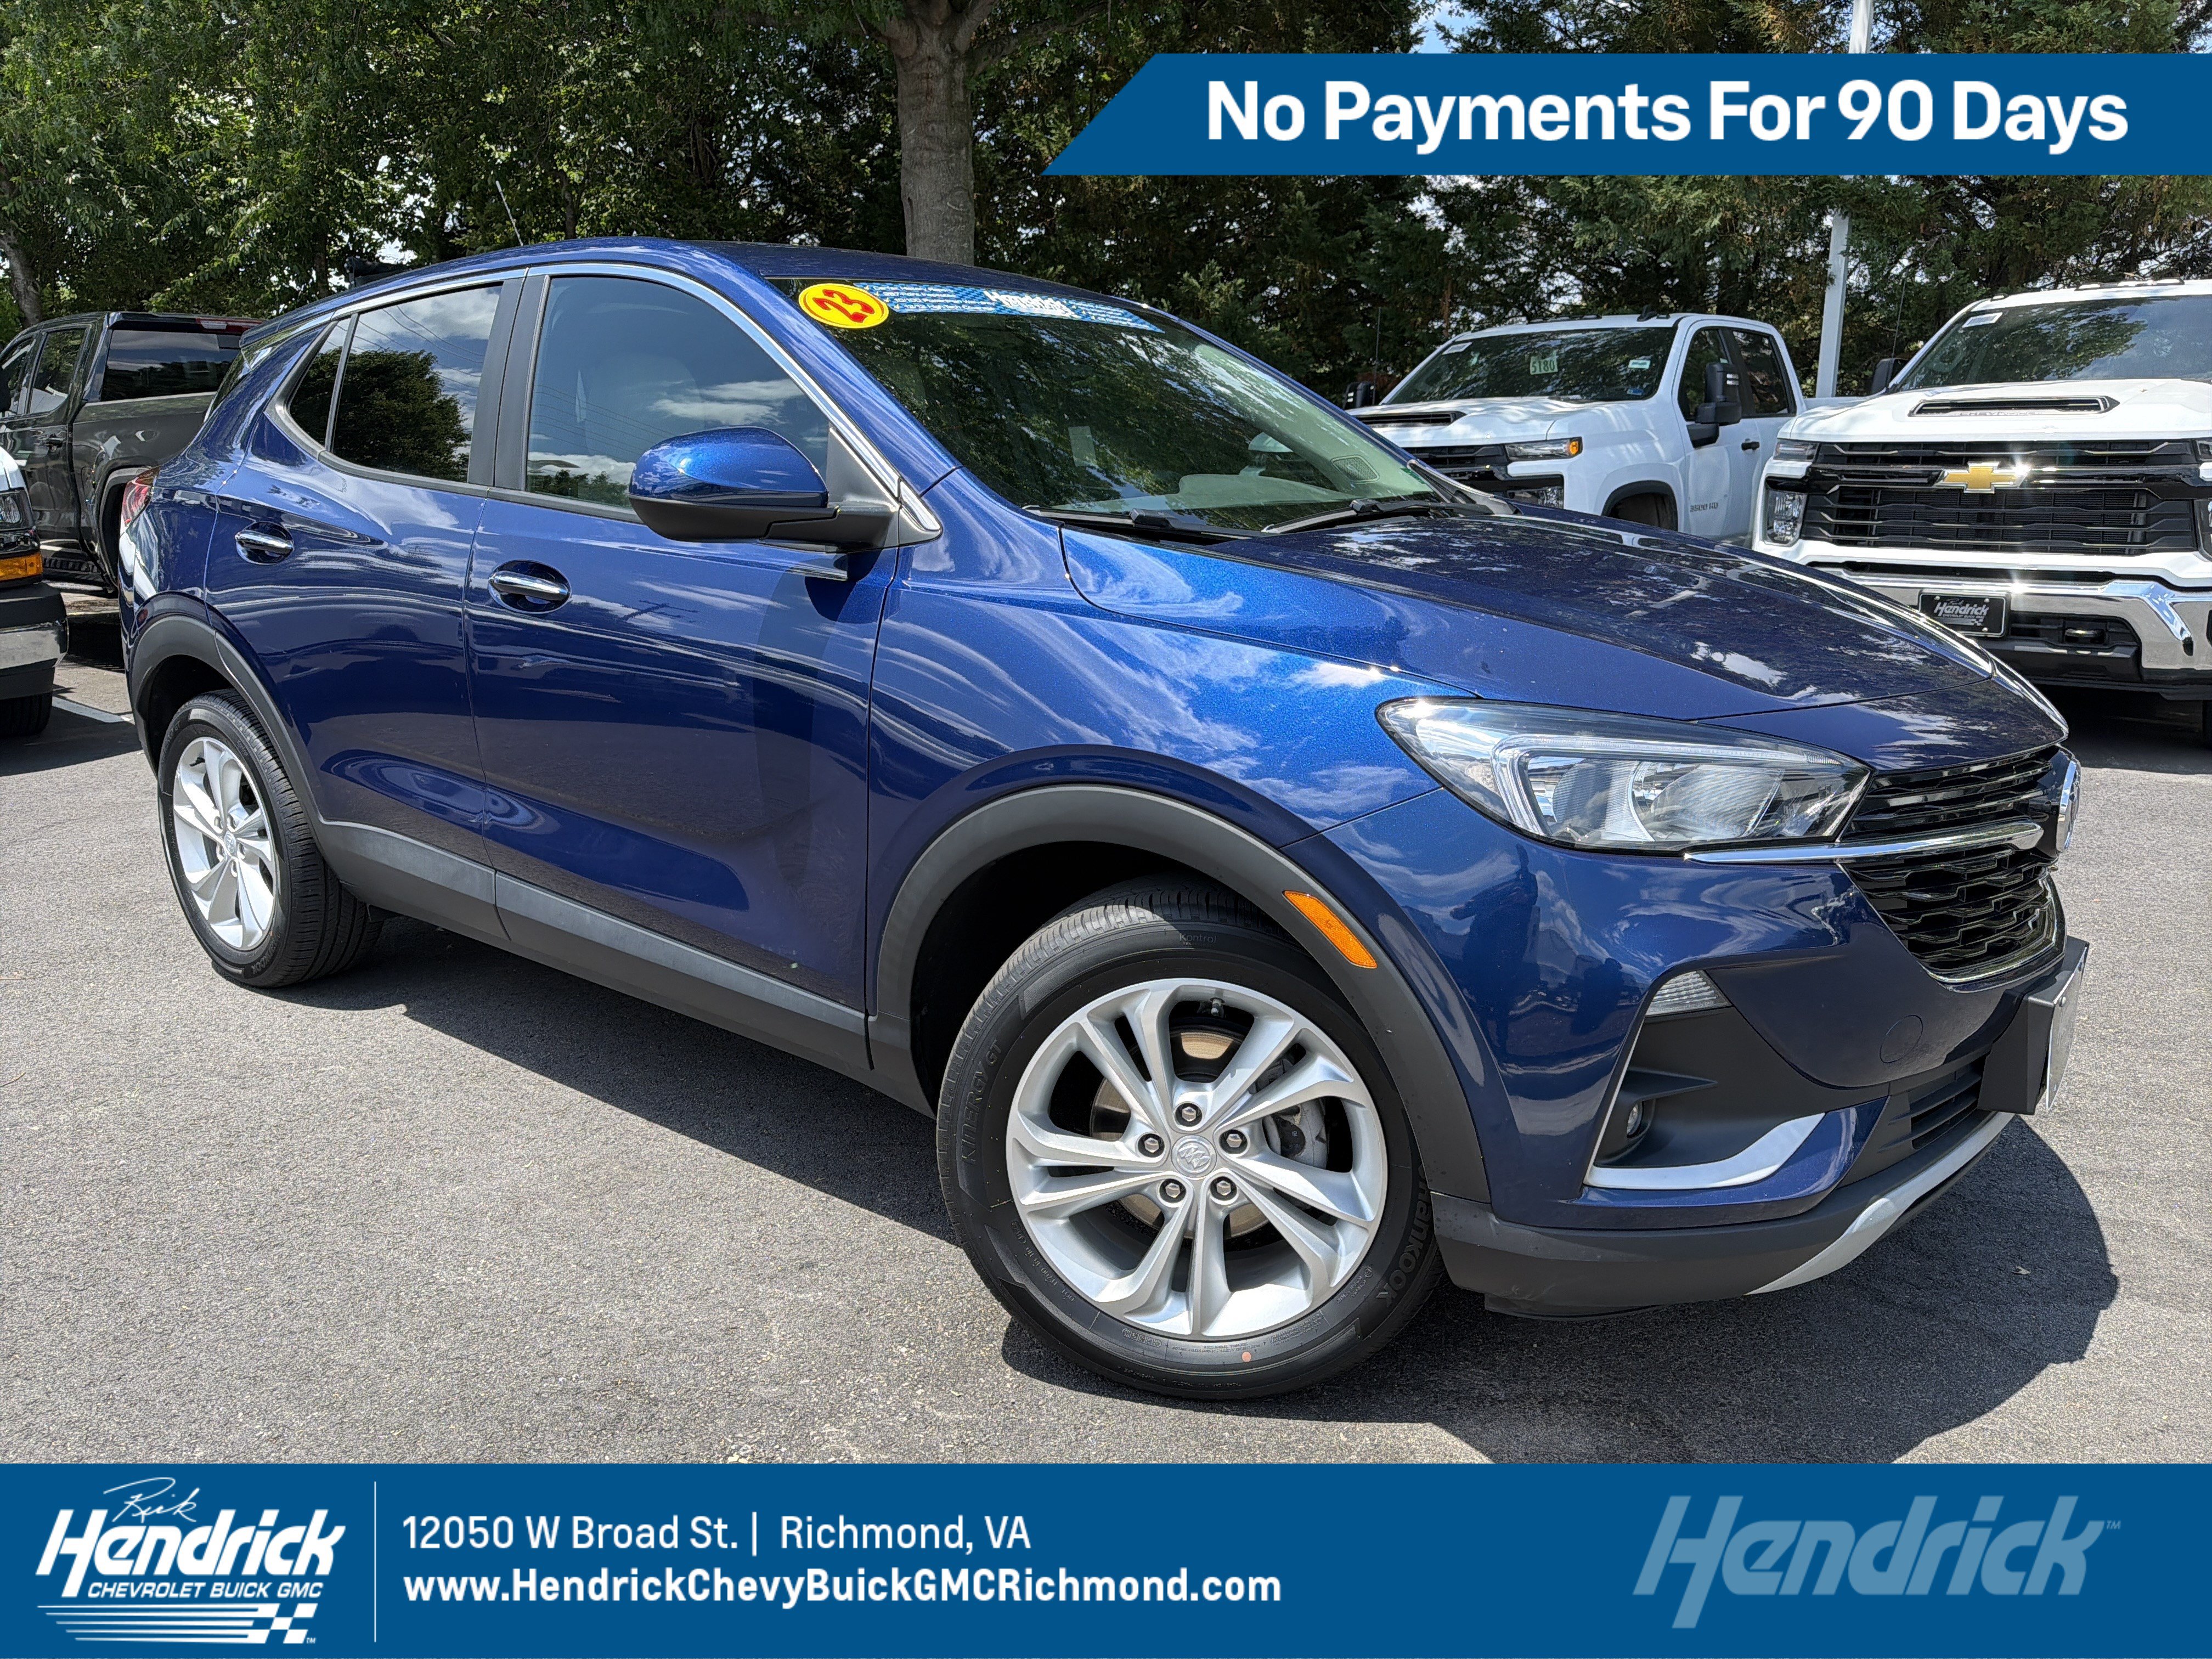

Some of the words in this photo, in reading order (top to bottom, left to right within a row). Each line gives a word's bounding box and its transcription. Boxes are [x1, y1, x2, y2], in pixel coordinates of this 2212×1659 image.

[812, 289, 875, 323] 23
[1532, 360, 1555, 373] 5180
[1933, 602, 1990, 616] Hendrick
[1180, 933, 1216, 943] Kontrol
